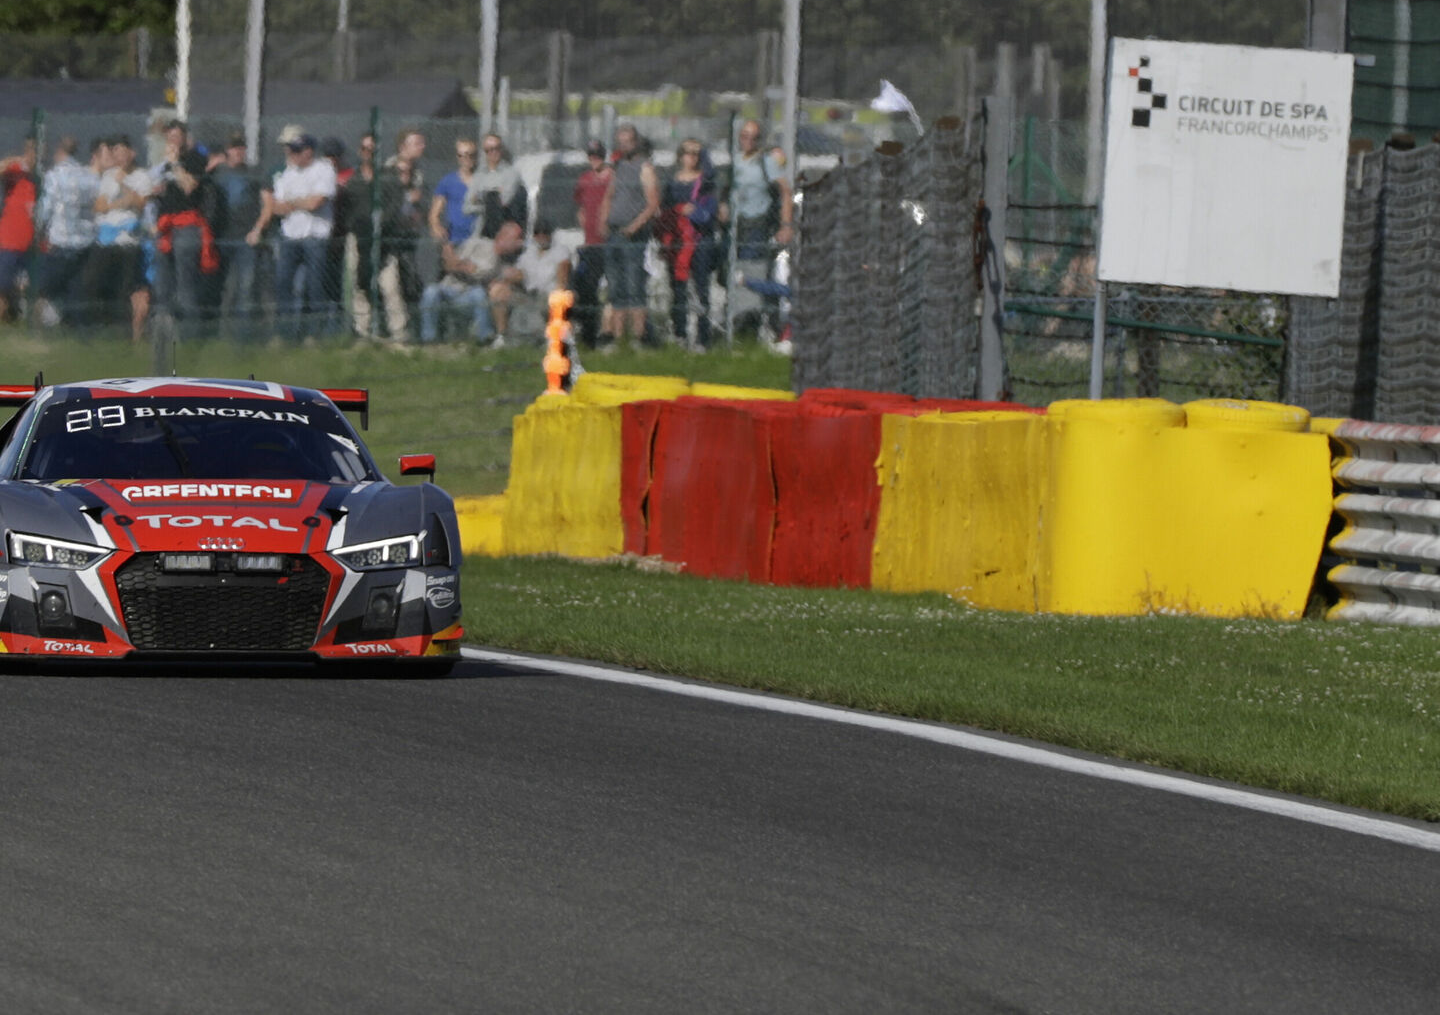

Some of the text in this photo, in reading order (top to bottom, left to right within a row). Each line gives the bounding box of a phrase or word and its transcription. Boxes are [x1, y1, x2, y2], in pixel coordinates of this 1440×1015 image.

[1177, 95, 1328, 121] CIRCUIT DE SPA
[1177, 117, 1329, 142] FRANCORCHAMPS
[66, 405, 126, 433] 29
[133, 406, 310, 425] BLANCPAIN
[136, 514, 298, 532] TOTAL
[44, 640, 95, 654] TOTAL
[345, 643, 397, 654] TOTAL
